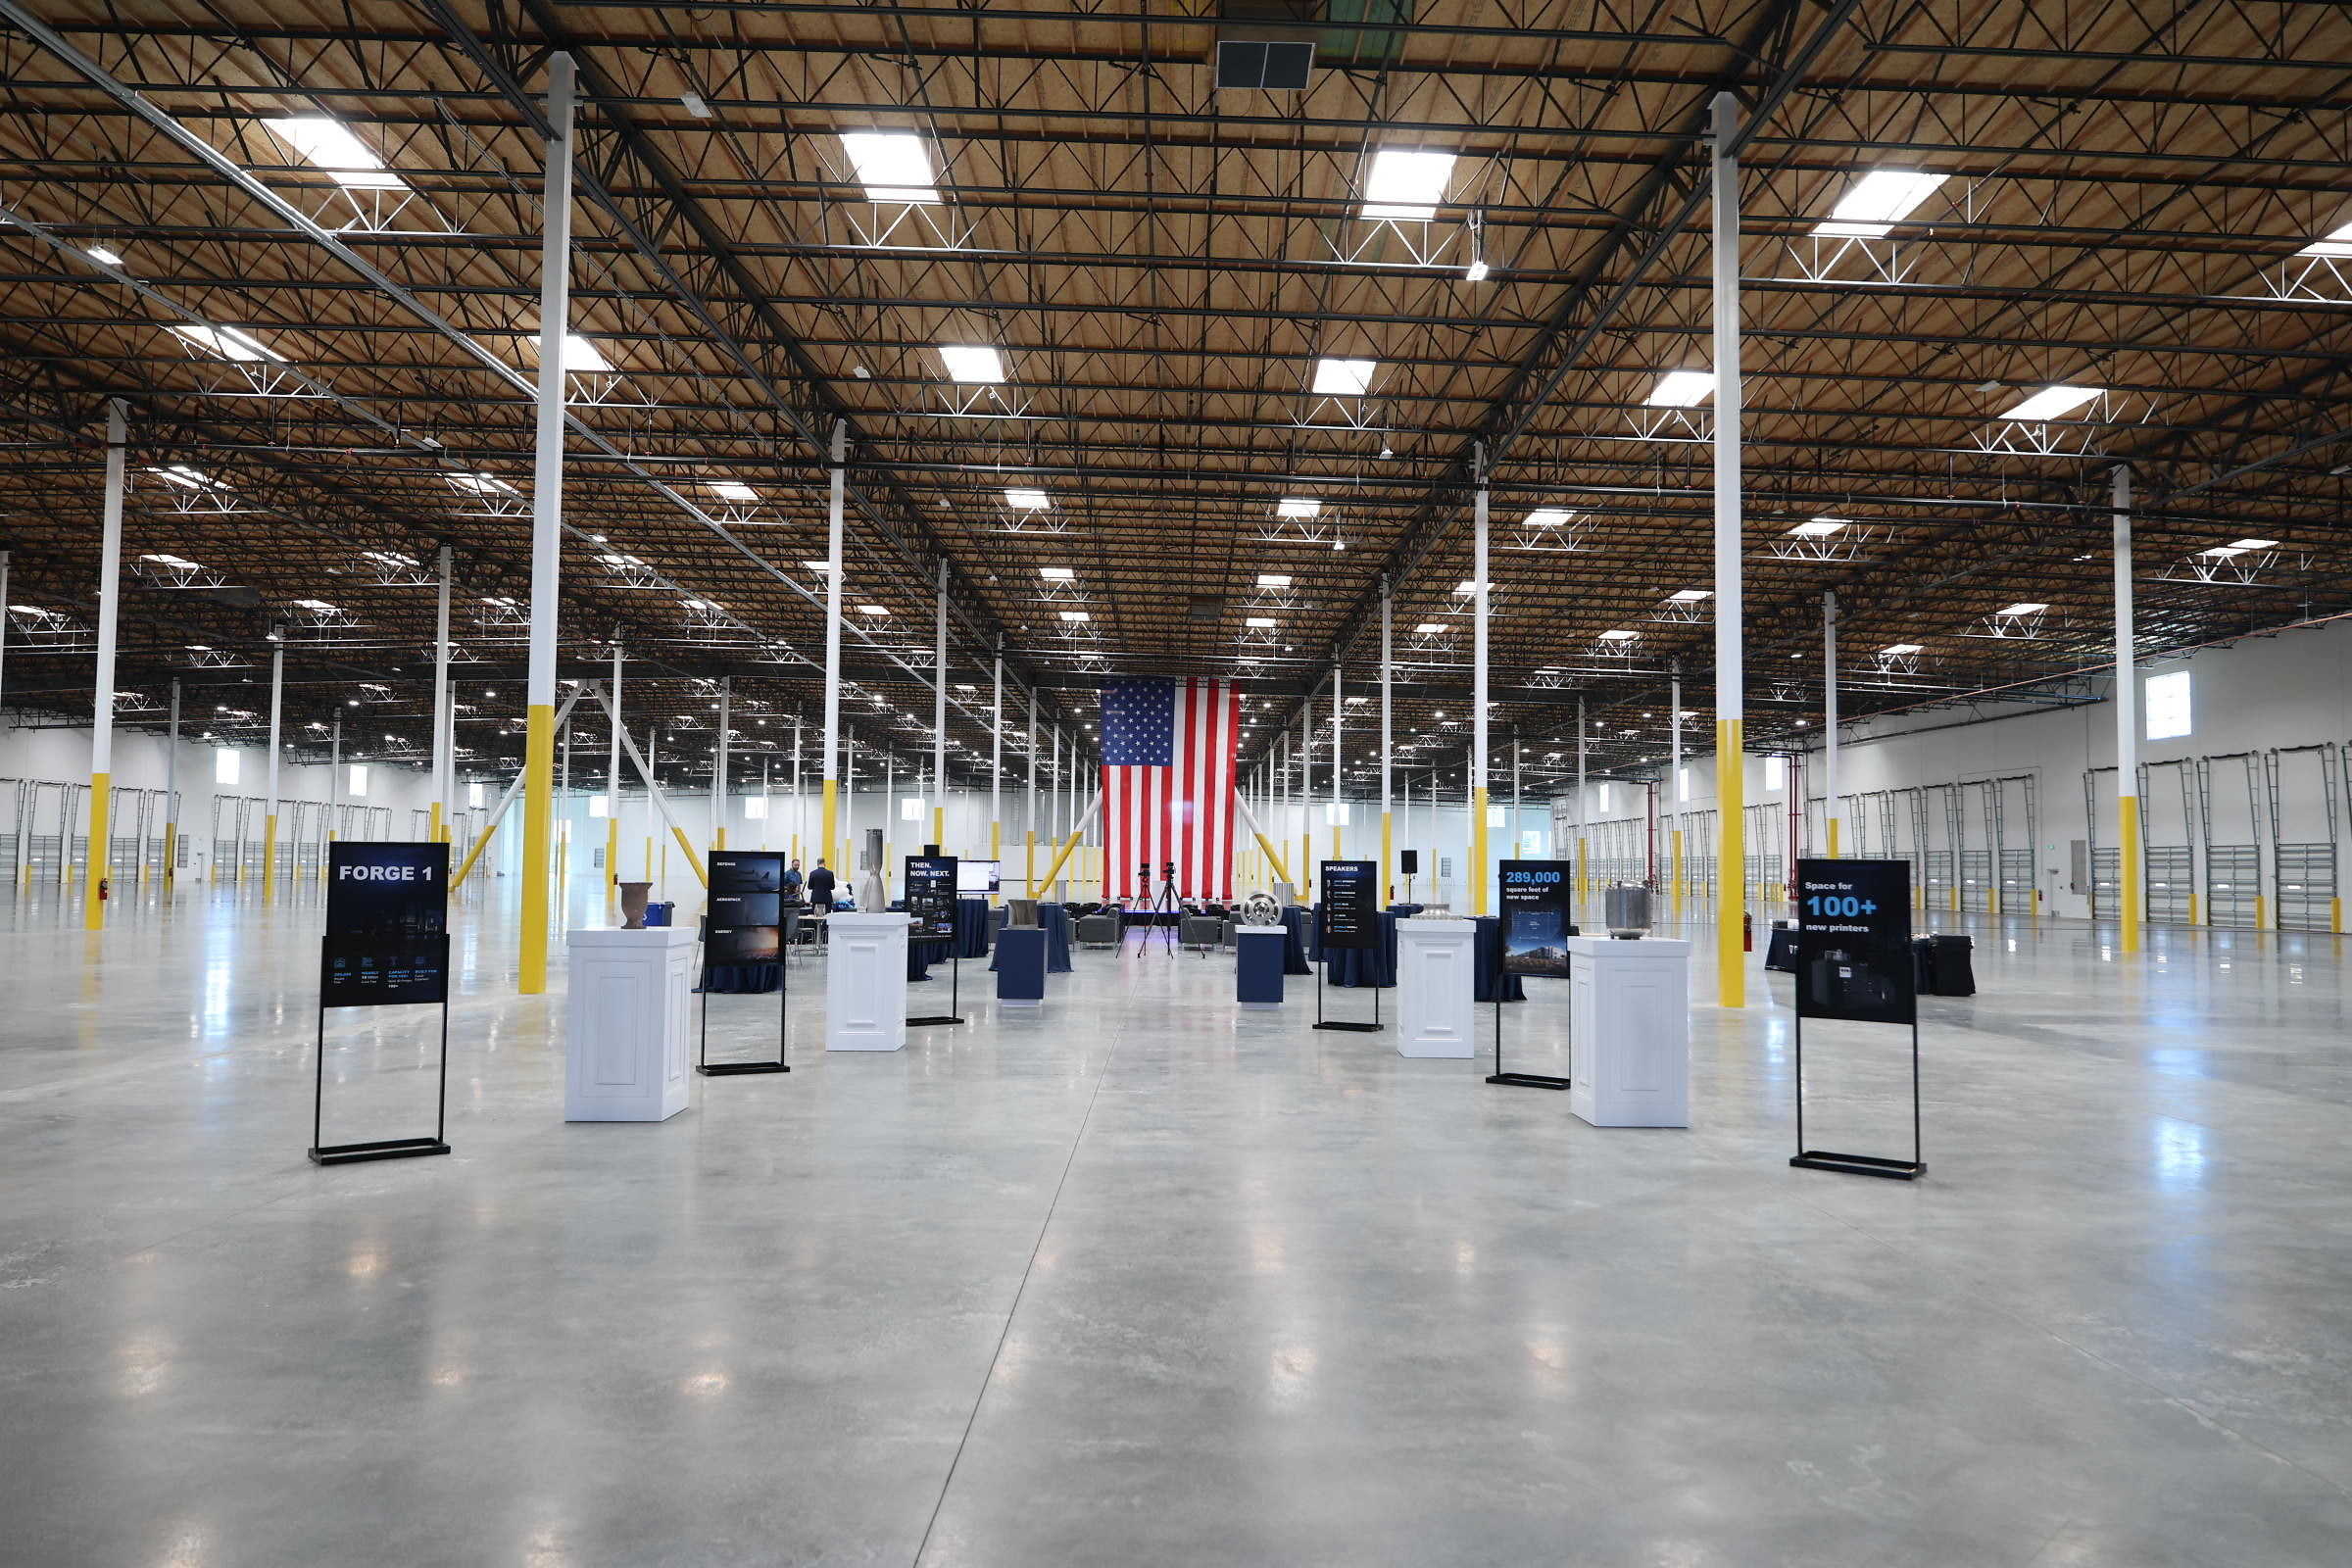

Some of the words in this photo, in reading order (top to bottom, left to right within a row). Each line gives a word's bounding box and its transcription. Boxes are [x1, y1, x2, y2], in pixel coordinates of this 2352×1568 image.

[339, 866, 415, 881] FORGE
[422, 866, 432, 881] 1
[1506, 871, 1561, 885] 289,000
[1805, 882, 1836, 891] Space
[1807, 896, 1878, 917] 100+
[1829, 923, 1870, 933] printers
